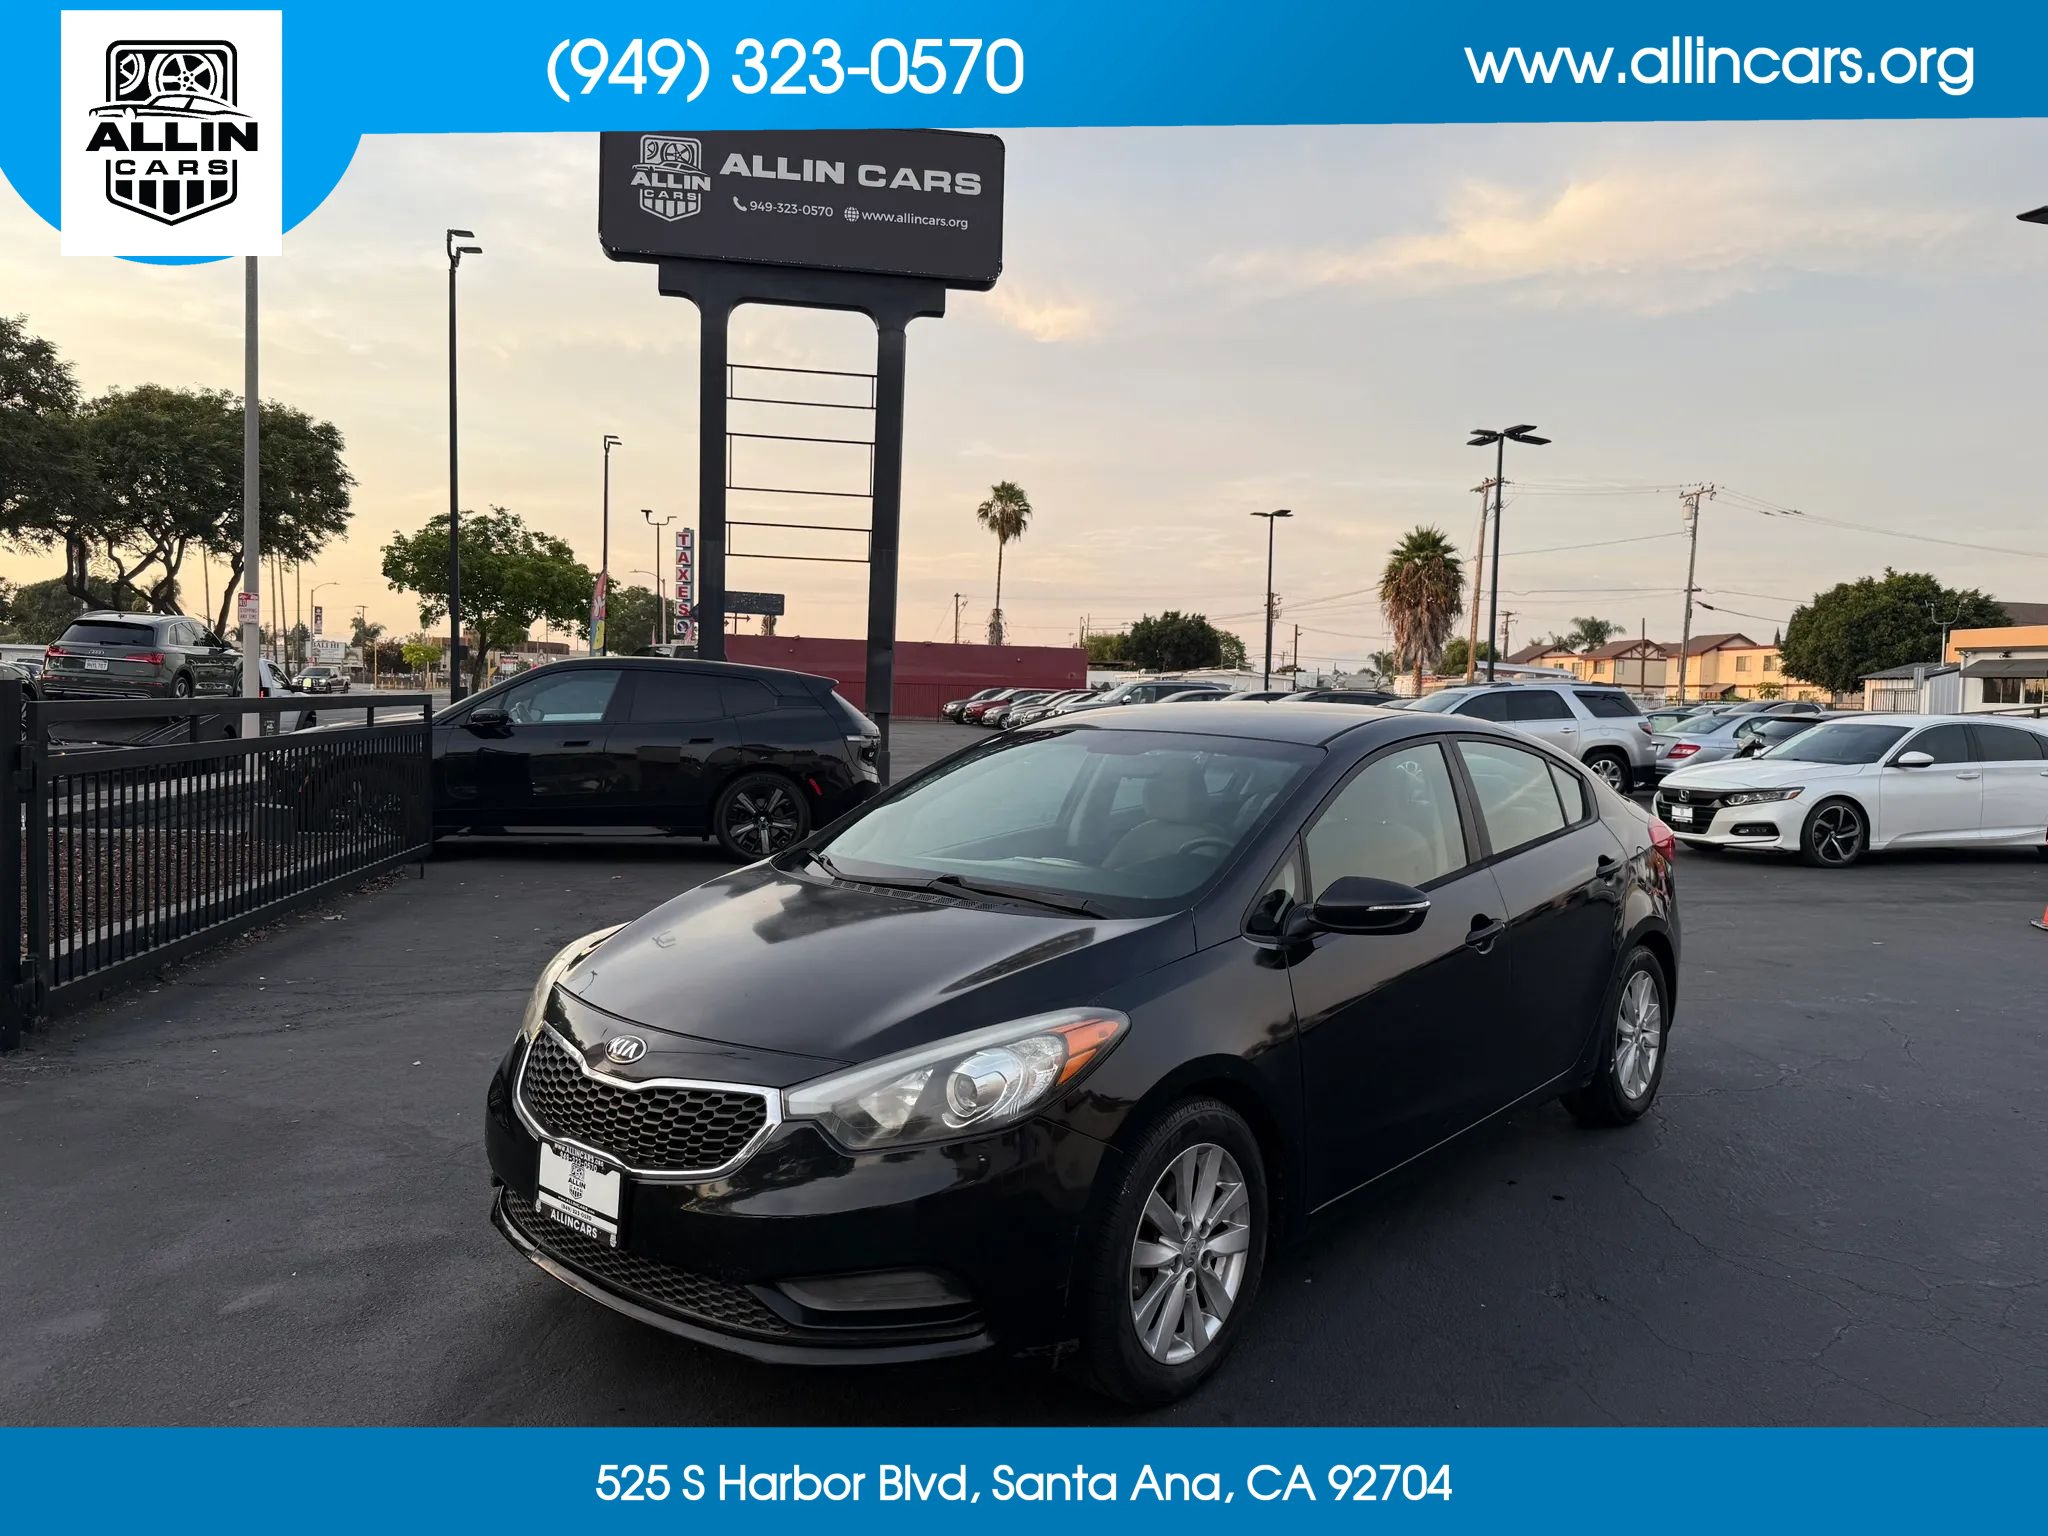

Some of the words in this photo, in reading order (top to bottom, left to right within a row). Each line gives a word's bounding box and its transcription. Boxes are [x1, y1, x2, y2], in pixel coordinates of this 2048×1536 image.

[630, 171, 711, 192] ALLIN
[719, 152, 845, 185] ALLIN
[857, 164, 982, 196] CARS
[643, 189, 697, 201] CARS
[749, 200, 834, 217] 949-323-0570
[861, 211, 969, 231] www.allincars.org
[677, 533, 690, 617] TAXES
[607, 1037, 639, 1059] KIA
[568, 1177, 586, 1190] ALLIN
[550, 1208, 598, 1239] ALLINCARS
